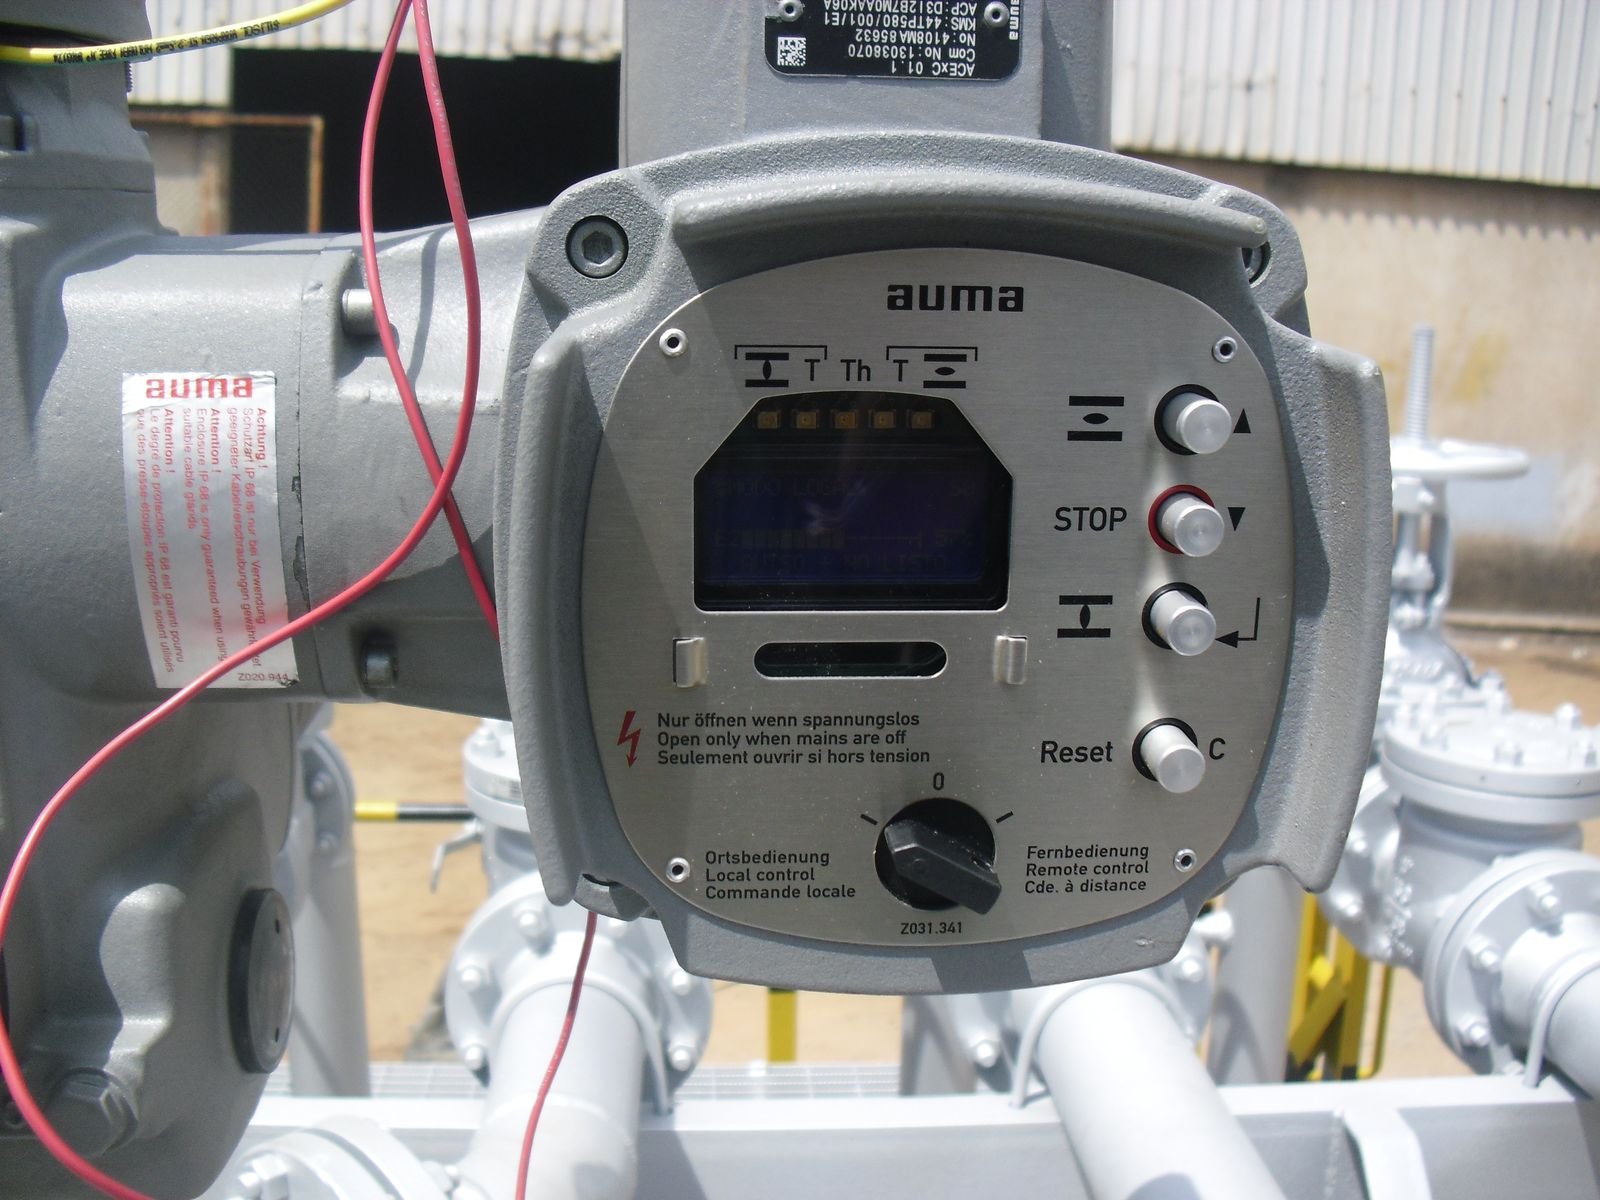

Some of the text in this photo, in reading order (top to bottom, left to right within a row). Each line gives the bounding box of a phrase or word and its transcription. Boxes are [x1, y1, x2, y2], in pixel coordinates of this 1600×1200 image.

[948, 48, 976, 61] Com
[891, 60, 975, 77] ACExC 01.1
[887, 284, 1024, 312] auma
[804, 358, 909, 382] T Th T
[146, 376, 253, 398] auma
[135, 408, 146, 429] que
[150, 408, 161, 423] Le
[137, 434, 148, 455] des
[163, 408, 174, 465] Attention
[196, 408, 207, 465] Enclosure
[210, 408, 222, 465] Attention
[227, 407, 240, 468] geeigneter
[243, 407, 254, 463] Schutzart
[255, 408, 267, 461] Achtung
[152, 464, 163, 478] de
[183, 408, 197, 529] suitable cable glands
[200, 470, 209, 482] IP
[245, 467, 255, 478] IP
[199, 486, 210, 500] 68
[244, 483, 256, 497] 68
[151, 482, 167, 537] protection
[1054, 506, 1128, 532] STOP
[200, 517, 211, 540] only
[248, 518, 257, 535] nur
[158, 542, 168, 553] IP
[231, 473, 250, 602] Kabelverschraubungen
[248, 539, 258, 556] bei
[159, 557, 170, 570] 68
[161, 574, 172, 589] est
[201, 544, 220, 605] guaranteed
[251, 560, 266, 624] Verwendung
[162, 593, 178, 627] garanti
[212, 607, 225, 634] when
[155, 609, 168, 639] soient
[170, 630, 184, 663] pourvu
[216, 636, 228, 662] using
[657, 712, 920, 730] Nur öffnen wenn spannungslos
[657, 730, 907, 749] Open only when mains are off
[1208, 737, 1226, 760] C
[657, 749, 930, 765] Seulement ouvrir si hors tension
[1040, 740, 1113, 763] Reset
[705, 851, 830, 866] Ortsbedienung
[1027, 845, 1149, 859] Fernbedienung
[705, 868, 815, 882] Local control
[1026, 861, 1149, 877] Remote control
[705, 885, 856, 899] Commande locale
[1024, 878, 1147, 894] Cde. à distance
[901, 922, 962, 934] Z031.341
